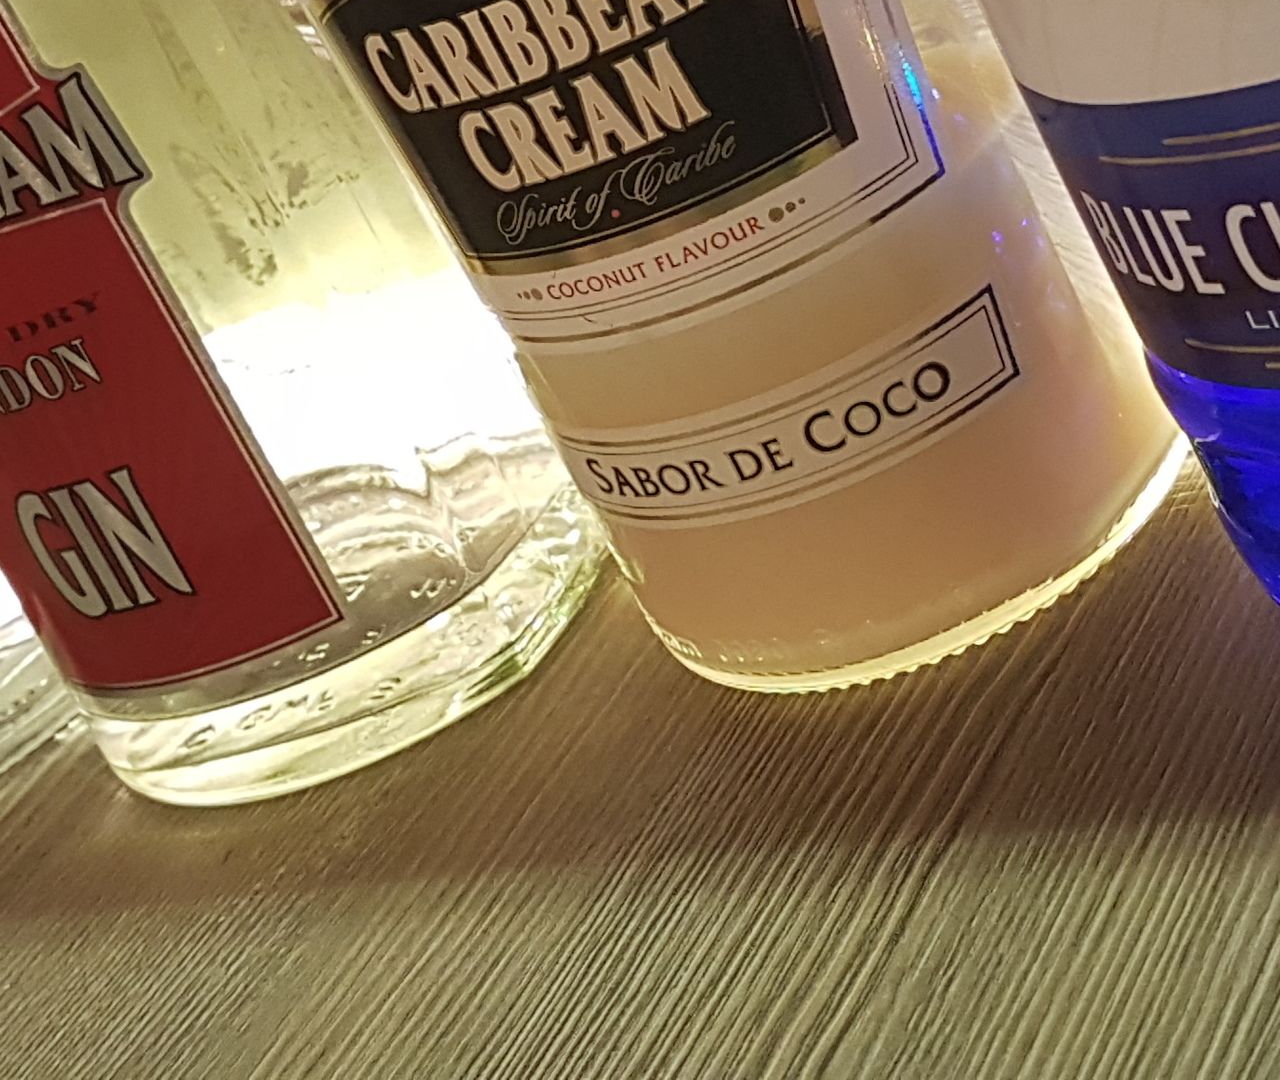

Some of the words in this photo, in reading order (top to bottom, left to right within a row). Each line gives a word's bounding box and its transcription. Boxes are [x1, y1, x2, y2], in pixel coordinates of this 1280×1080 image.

[458, 36, 713, 194] CREAM
[496, 185, 583, 246] Spirit
[572, 169, 625, 231] of
[619, 120, 738, 206] Caribe
[1080, 188, 1226, 296] BLUE
[6, 291, 101, 343] DRY
[546, 261, 649, 301] COCONUT
[653, 215, 766, 274] FLAVOUR
[585, 456, 725, 498] SABOR
[727, 437, 794, 484] DE
[803, 360, 952, 453] COCO
[14, 464, 197, 620] GIN
